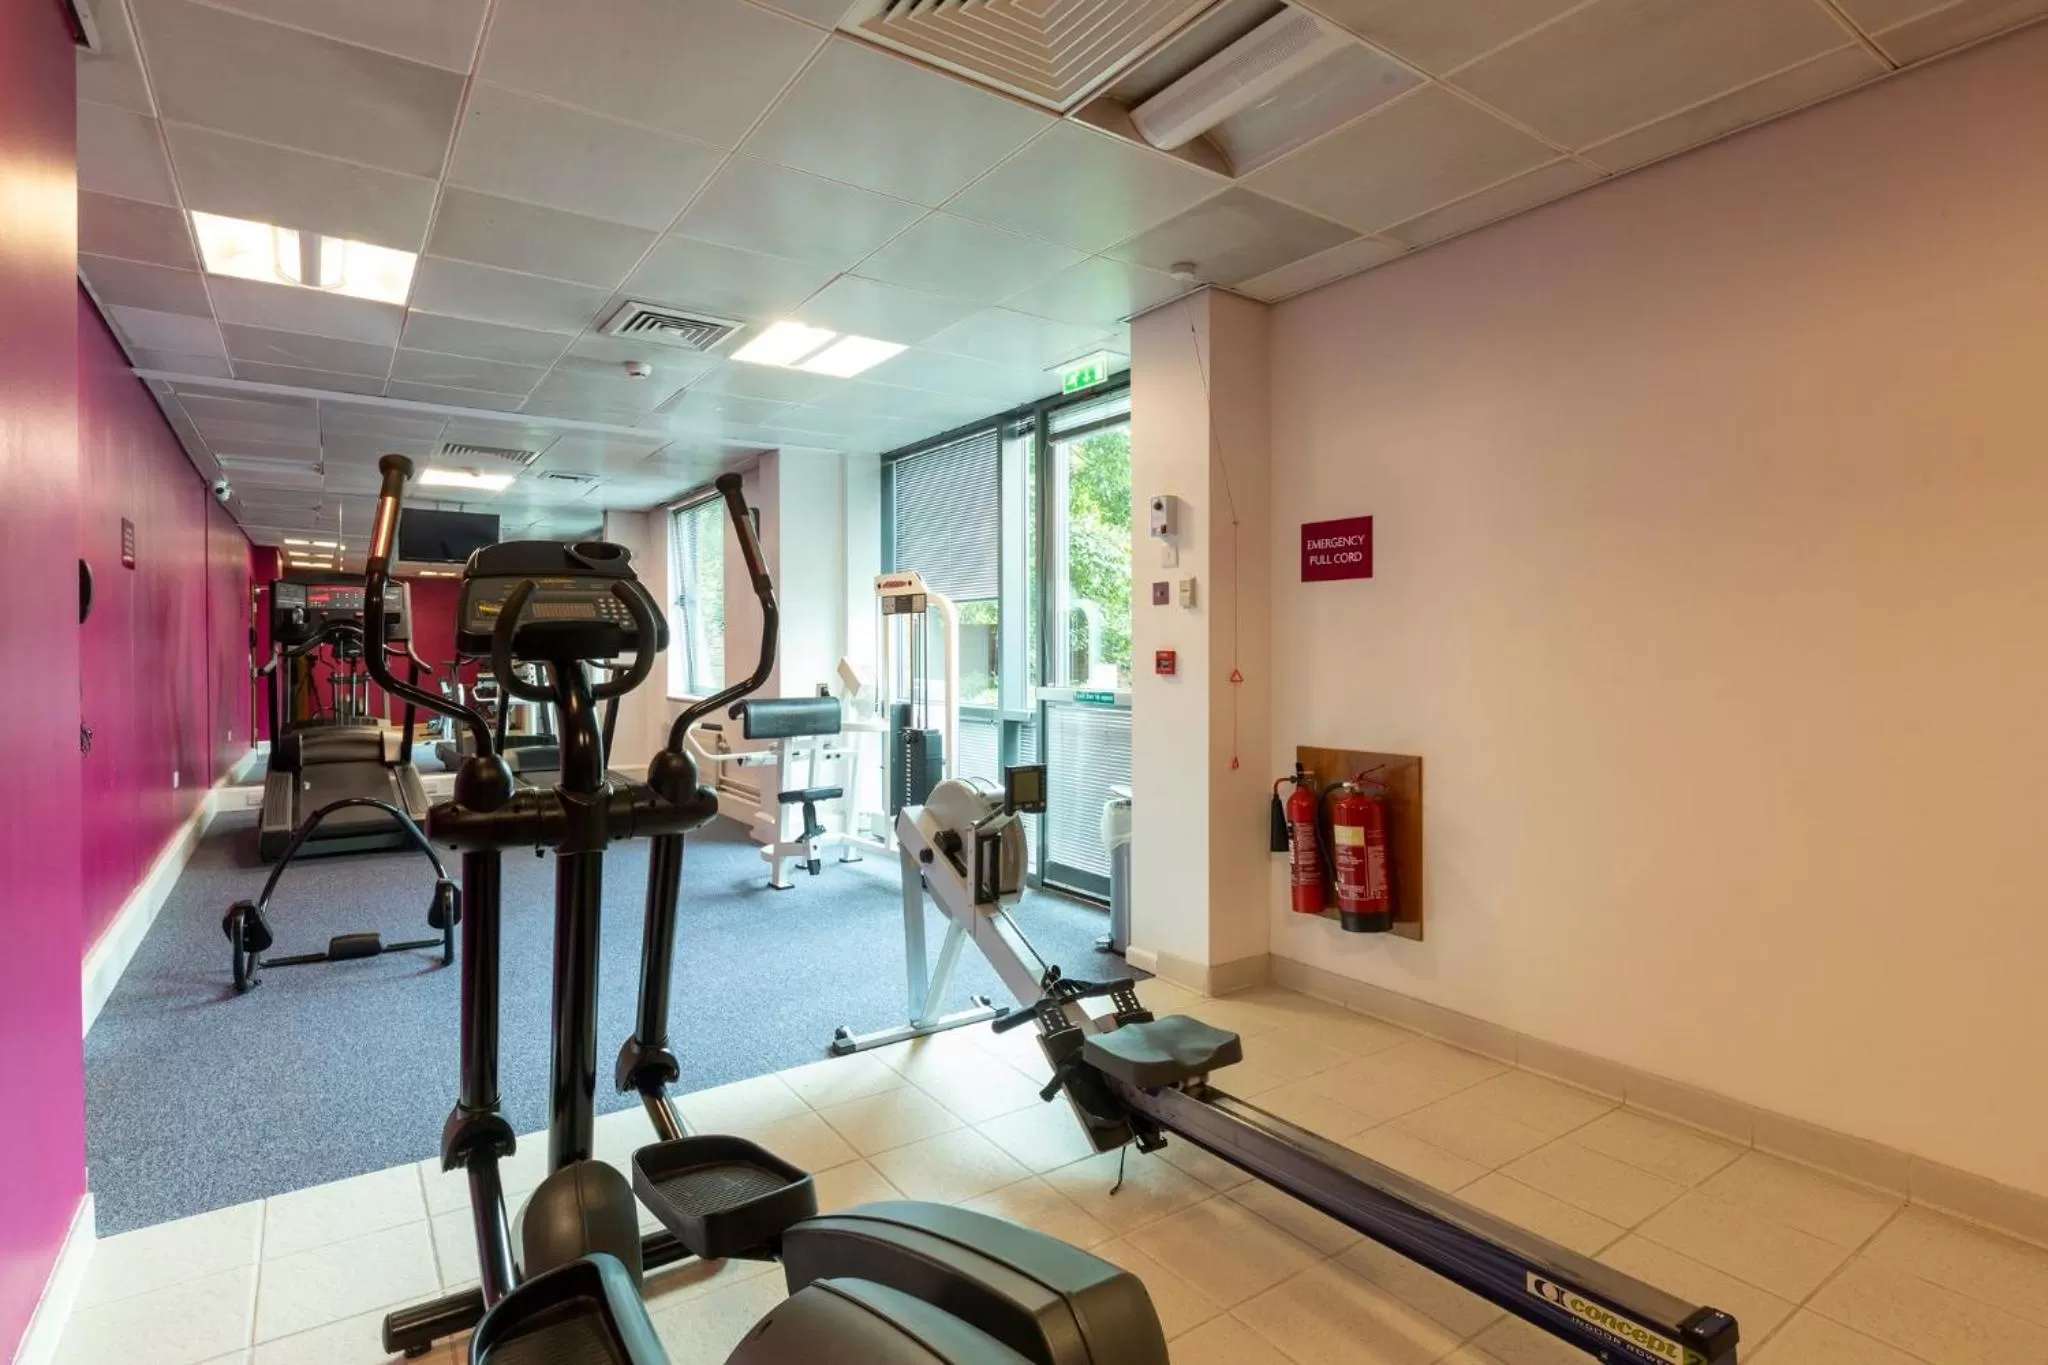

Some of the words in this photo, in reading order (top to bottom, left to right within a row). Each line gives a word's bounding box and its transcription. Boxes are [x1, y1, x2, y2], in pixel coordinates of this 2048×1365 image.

[1307, 533, 1366, 550] EMERGENCY
[1309, 554, 1332, 566] PULL
[1333, 551, 1363, 564] CORD
[1570, 1298, 1677, 1358] concept
